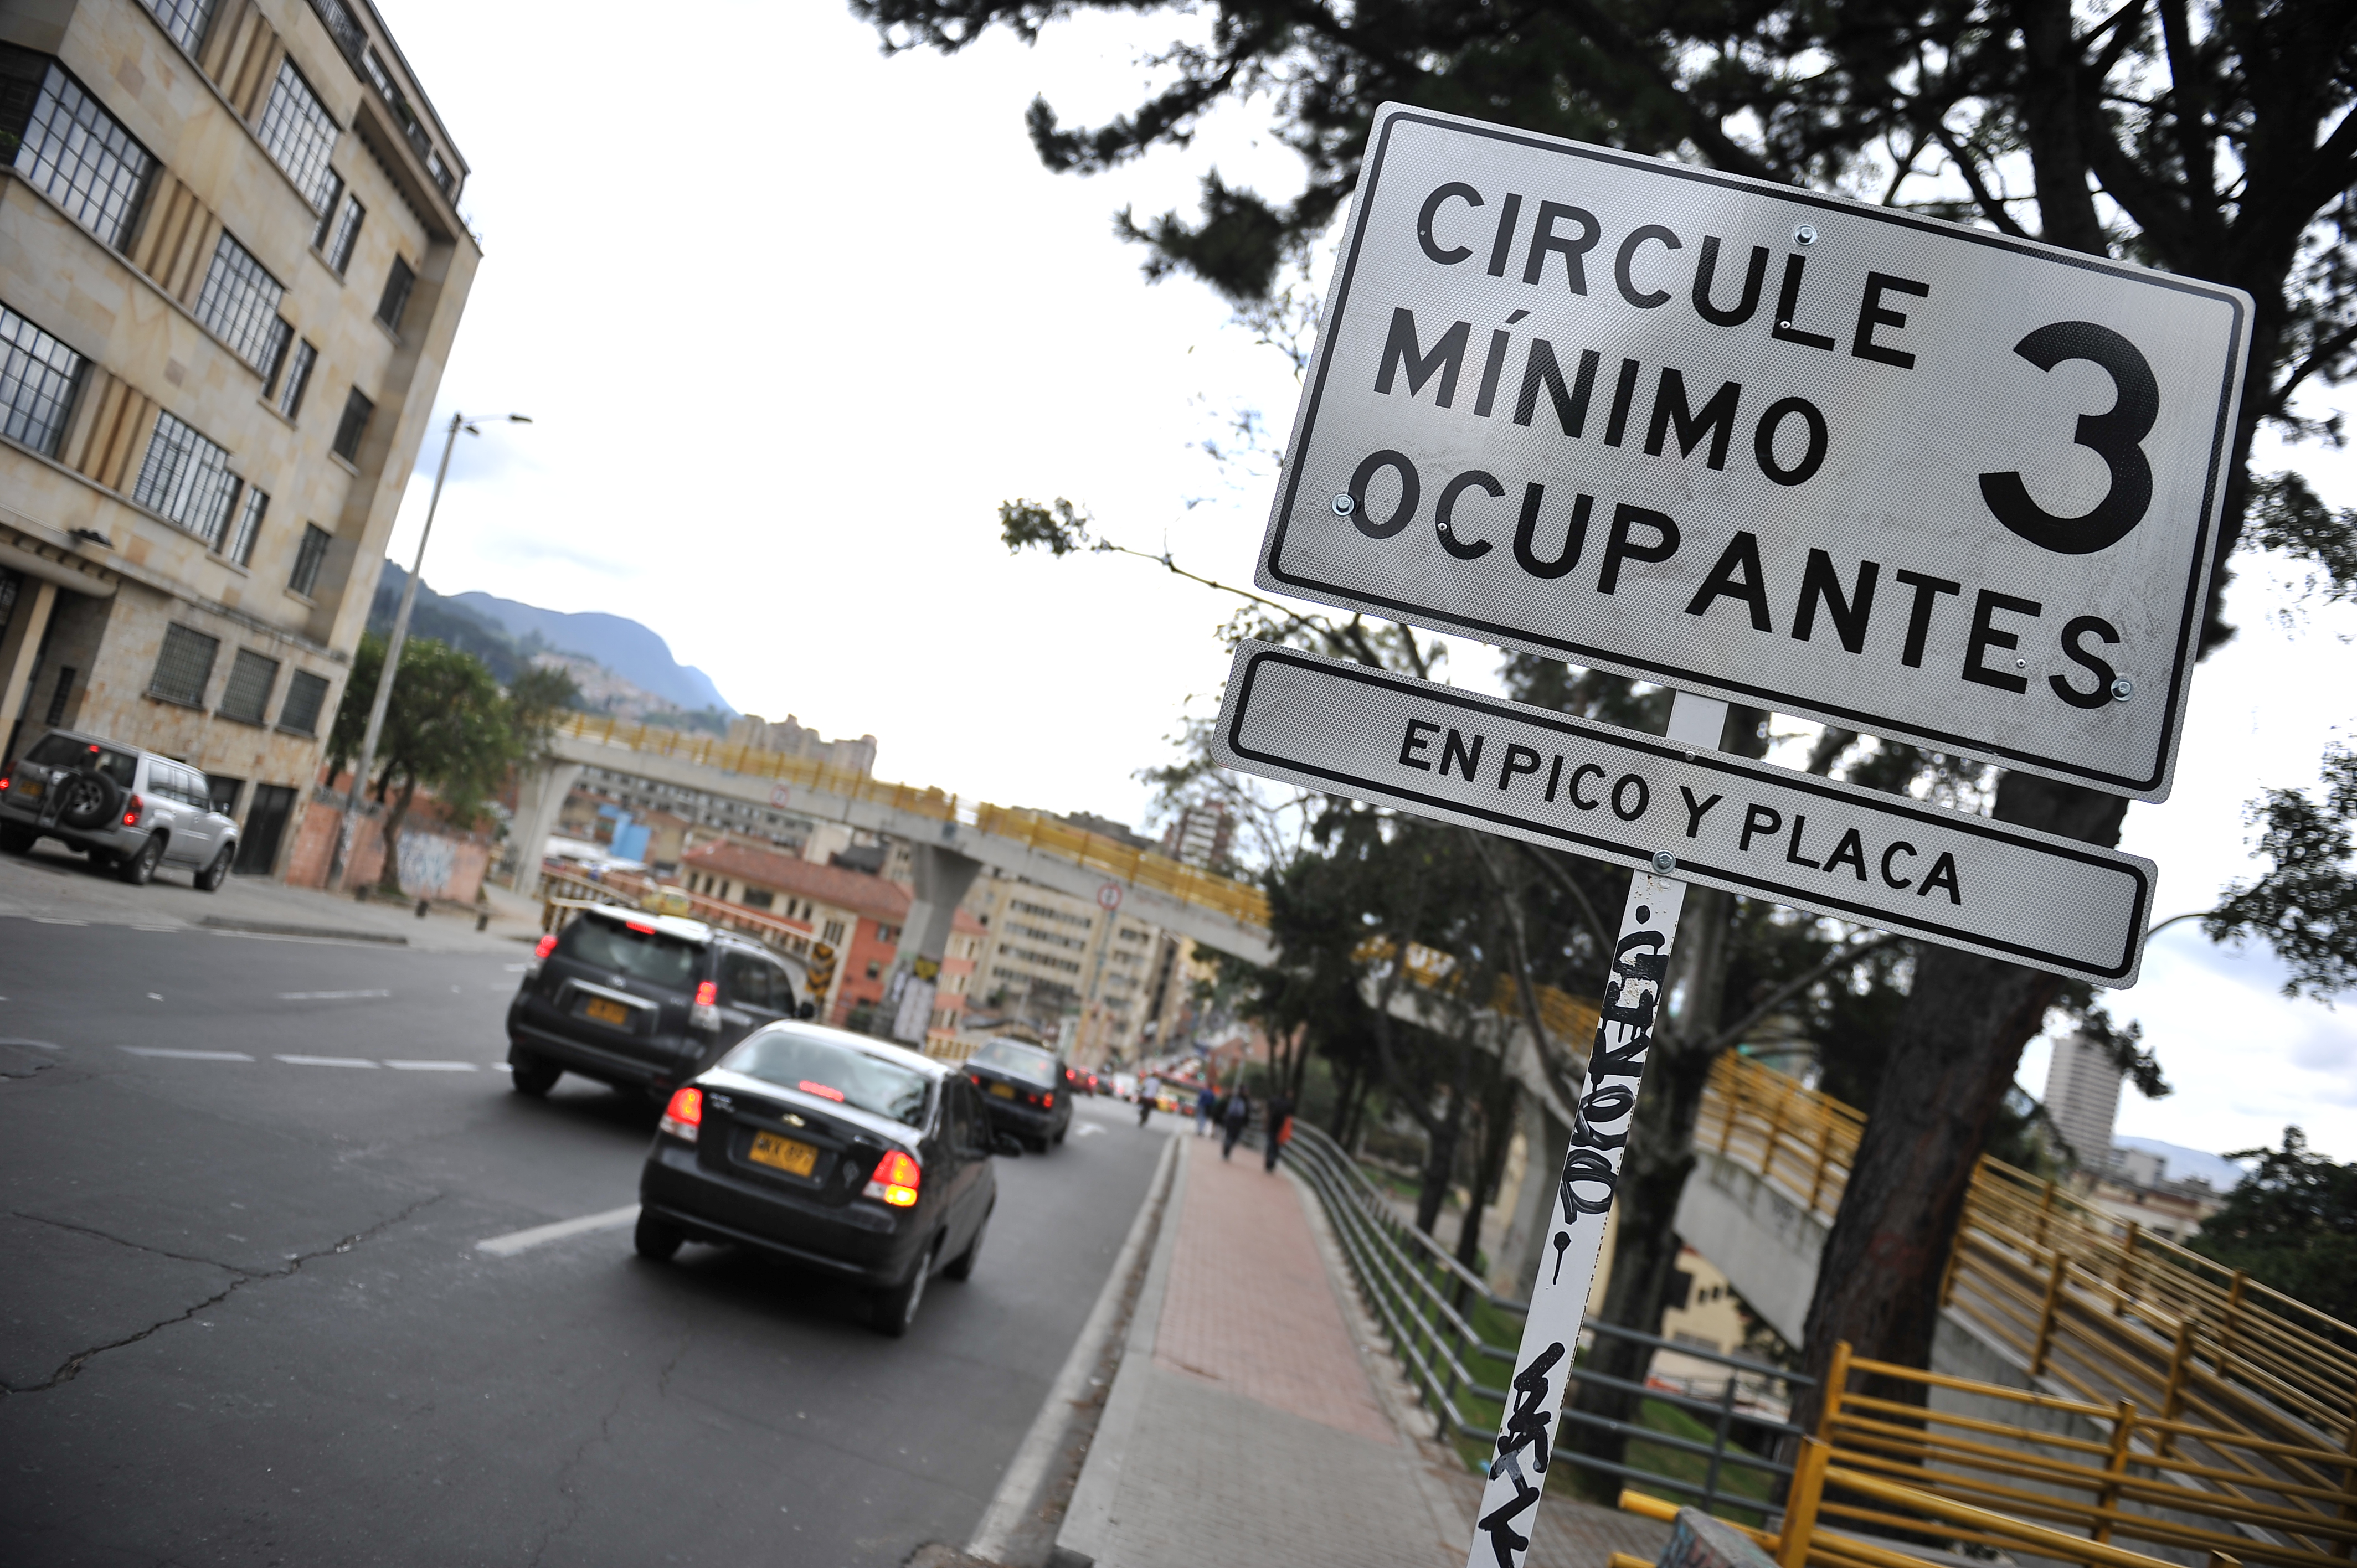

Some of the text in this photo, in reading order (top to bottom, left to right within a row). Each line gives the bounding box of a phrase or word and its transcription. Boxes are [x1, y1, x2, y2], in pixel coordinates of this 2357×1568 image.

[1417, 183, 1930, 370] CIRCULE
[1374, 307, 1829, 487] MÍNIMO
[1978, 322, 2159, 555] 3
[1350, 449, 2124, 709] OCUPANTES
[1399, 718, 1960, 904] EN PICO Y PLACA
